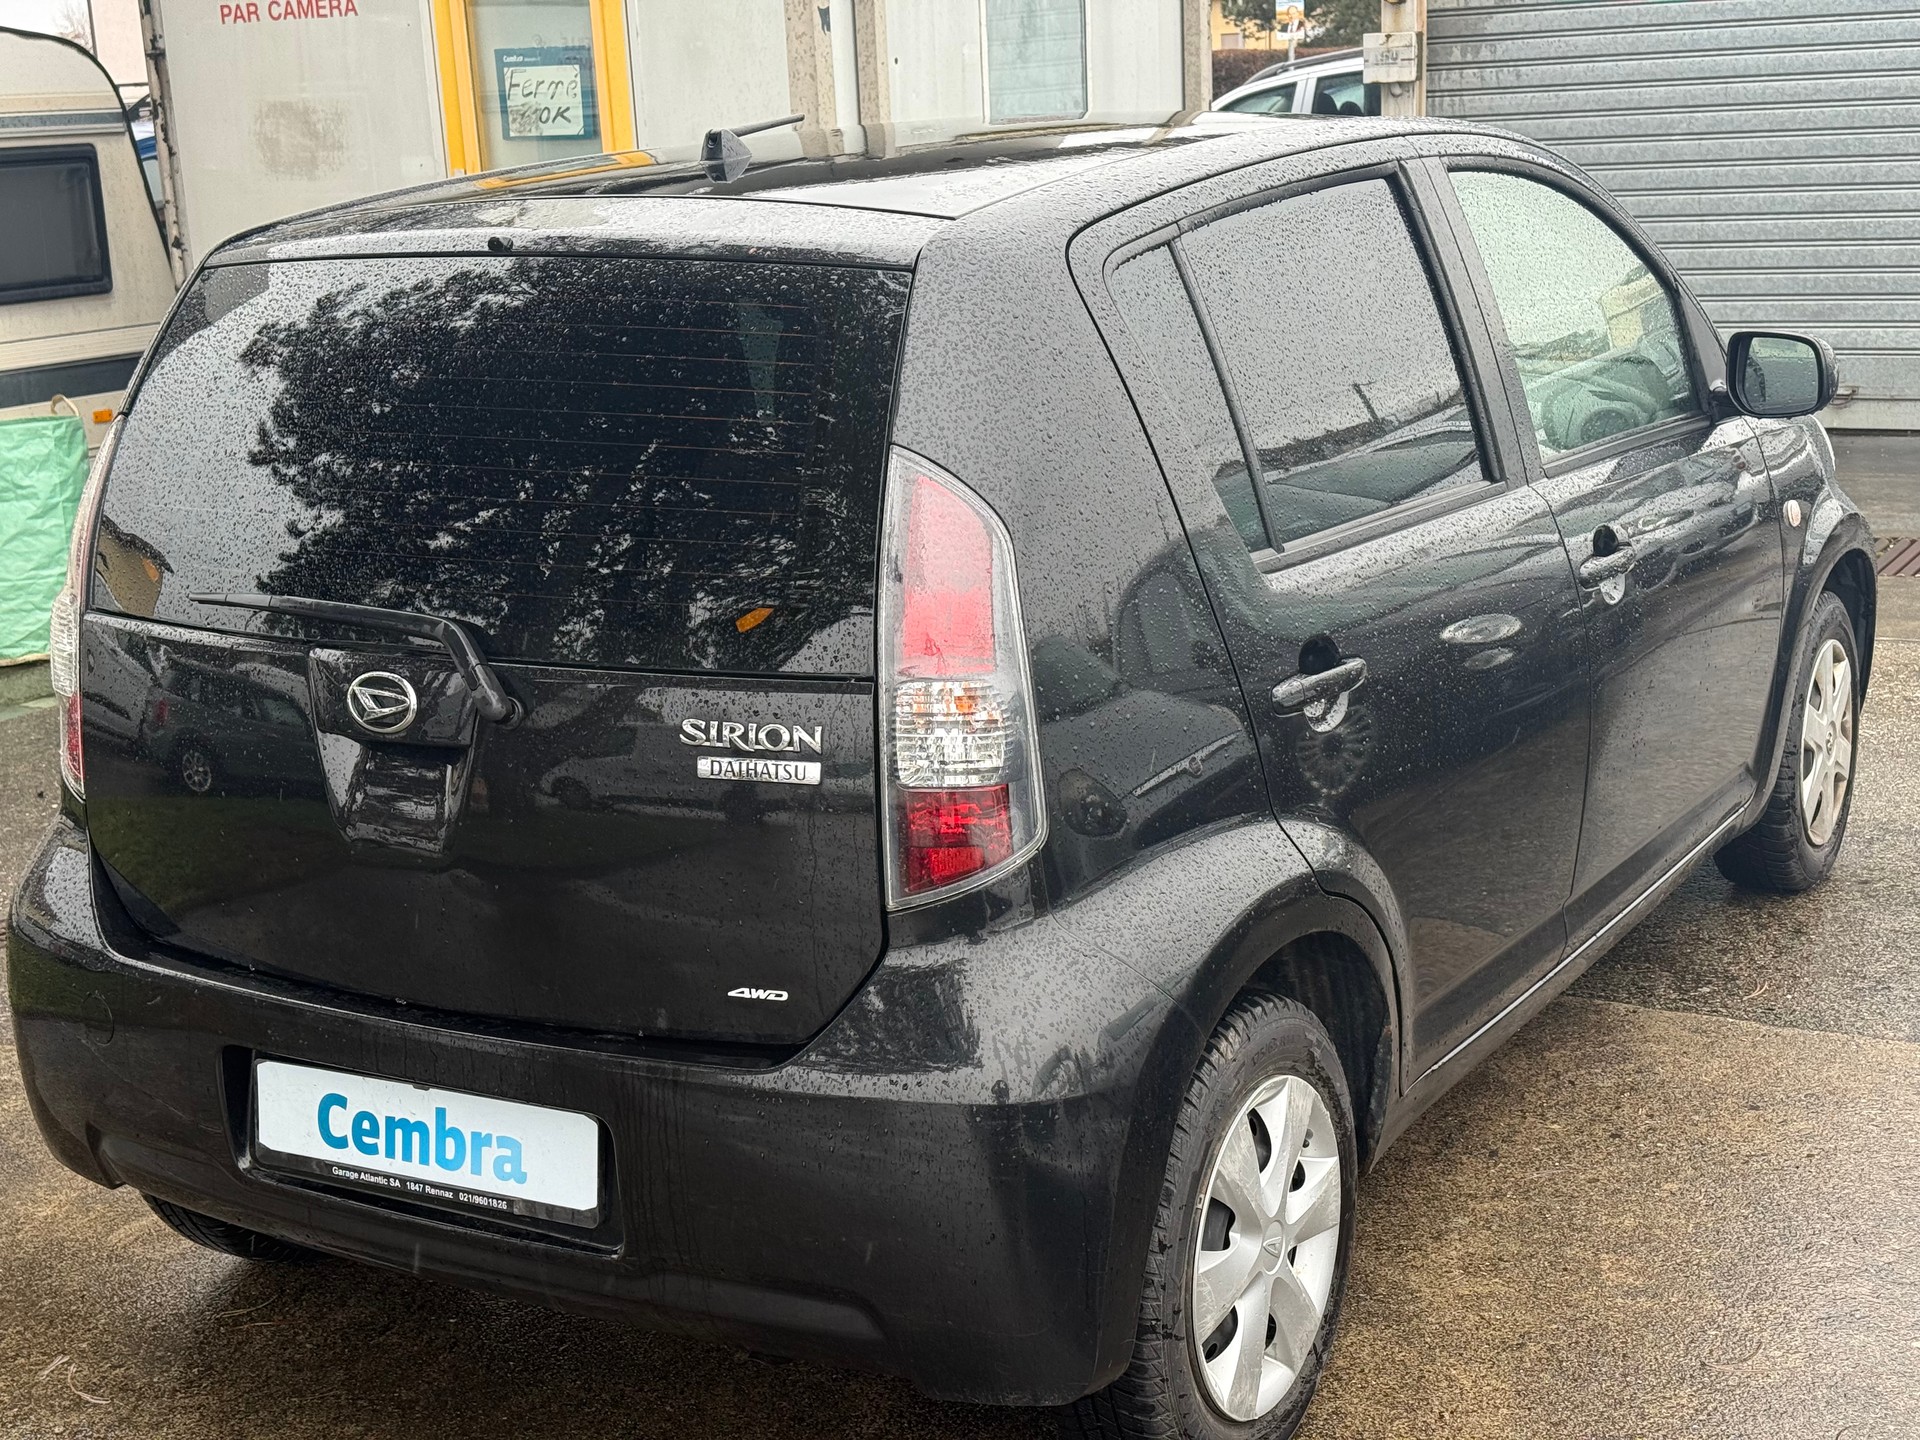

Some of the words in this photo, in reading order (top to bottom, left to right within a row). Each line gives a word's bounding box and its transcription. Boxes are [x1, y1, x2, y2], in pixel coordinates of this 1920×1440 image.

[220, 3, 261, 24] PAR
[268, 0, 359, 21] CAMERA
[679, 718, 823, 754] SIRION
[709, 759, 807, 781] DAIHATSU
[727, 987, 789, 1001] 4WD
[317, 1092, 528, 1185] Cembra
[332, 1166, 359, 1180] Garage
[360, 1171, 388, 1186] Atlantic
[389, 1177, 401, 1188] SA
[406, 1181, 424, 1192] 1847
[425, 1185, 454, 1199] Rennaz
[458, 1192, 508, 1210] 021/9601826
